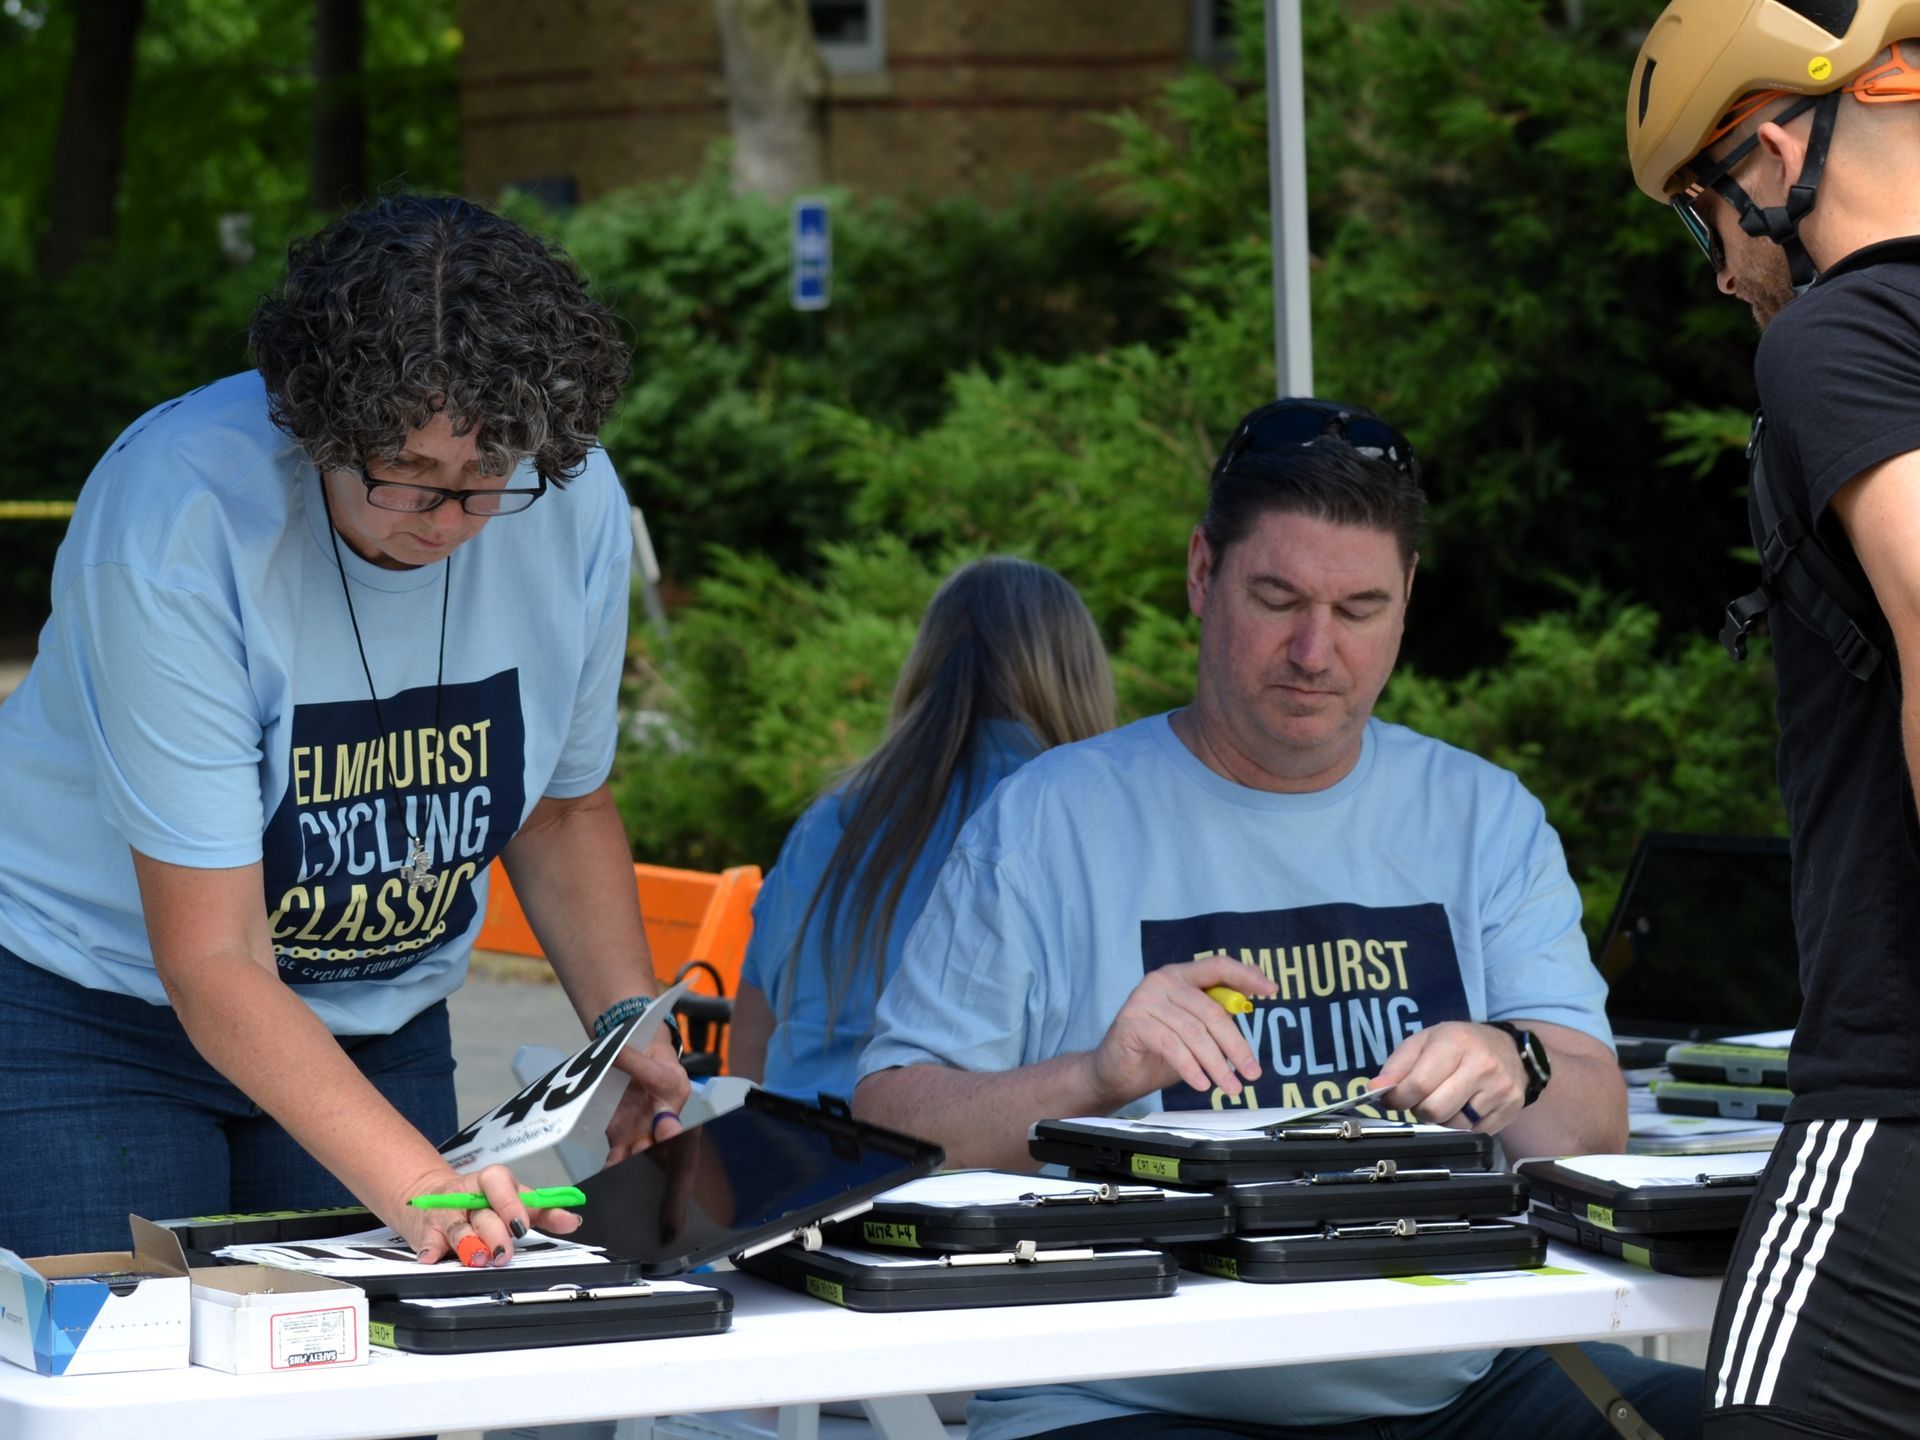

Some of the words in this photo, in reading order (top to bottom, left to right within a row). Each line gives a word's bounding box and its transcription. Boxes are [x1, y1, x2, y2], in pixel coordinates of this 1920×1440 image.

[293, 719, 491, 806] ELMHURST
[296, 785, 491, 883] CYCLING
[302, 967, 360, 982] CYCLING
[1193, 938, 1409, 1001] MHURST
[1228, 996, 1424, 1077] YCLING
[1137, 1159, 1149, 1171] CAT
[309, 1350, 337, 1363] SAFETY
